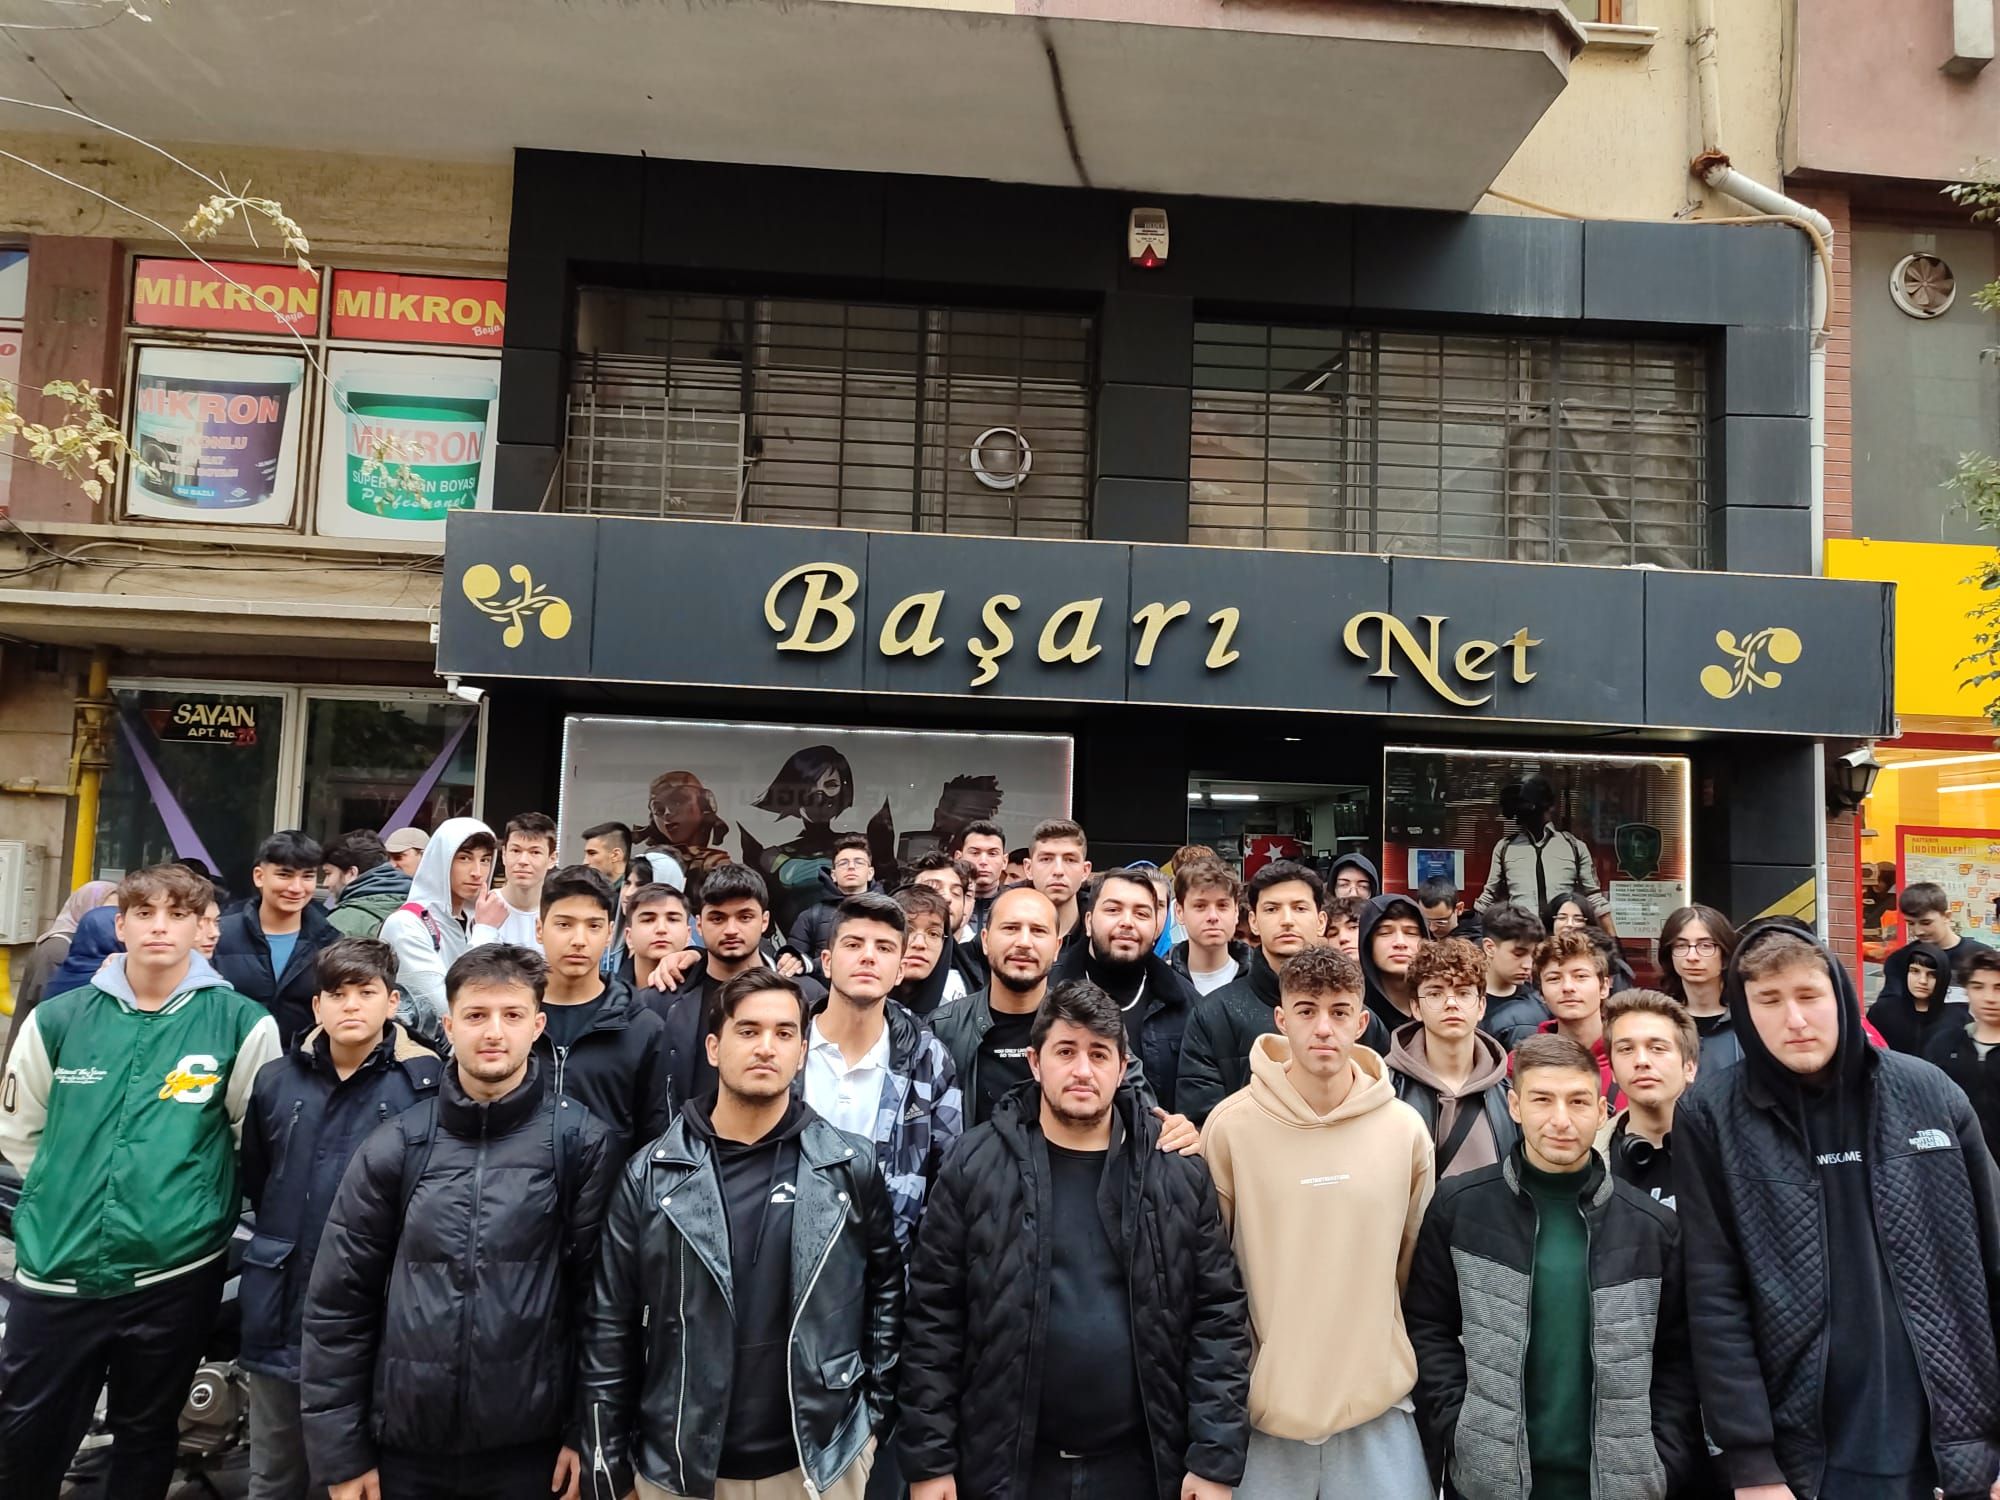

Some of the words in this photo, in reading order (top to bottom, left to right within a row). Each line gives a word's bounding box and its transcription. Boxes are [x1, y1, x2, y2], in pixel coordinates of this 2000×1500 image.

[136, 273, 318, 315] MİKRON
[472, 325, 502, 337] Boya
[440, 477, 476, 493] BOYASI
[764, 562, 1240, 687] Başarı
[1343, 611, 1544, 707] Net
[173, 704, 255, 727] SAYAN
